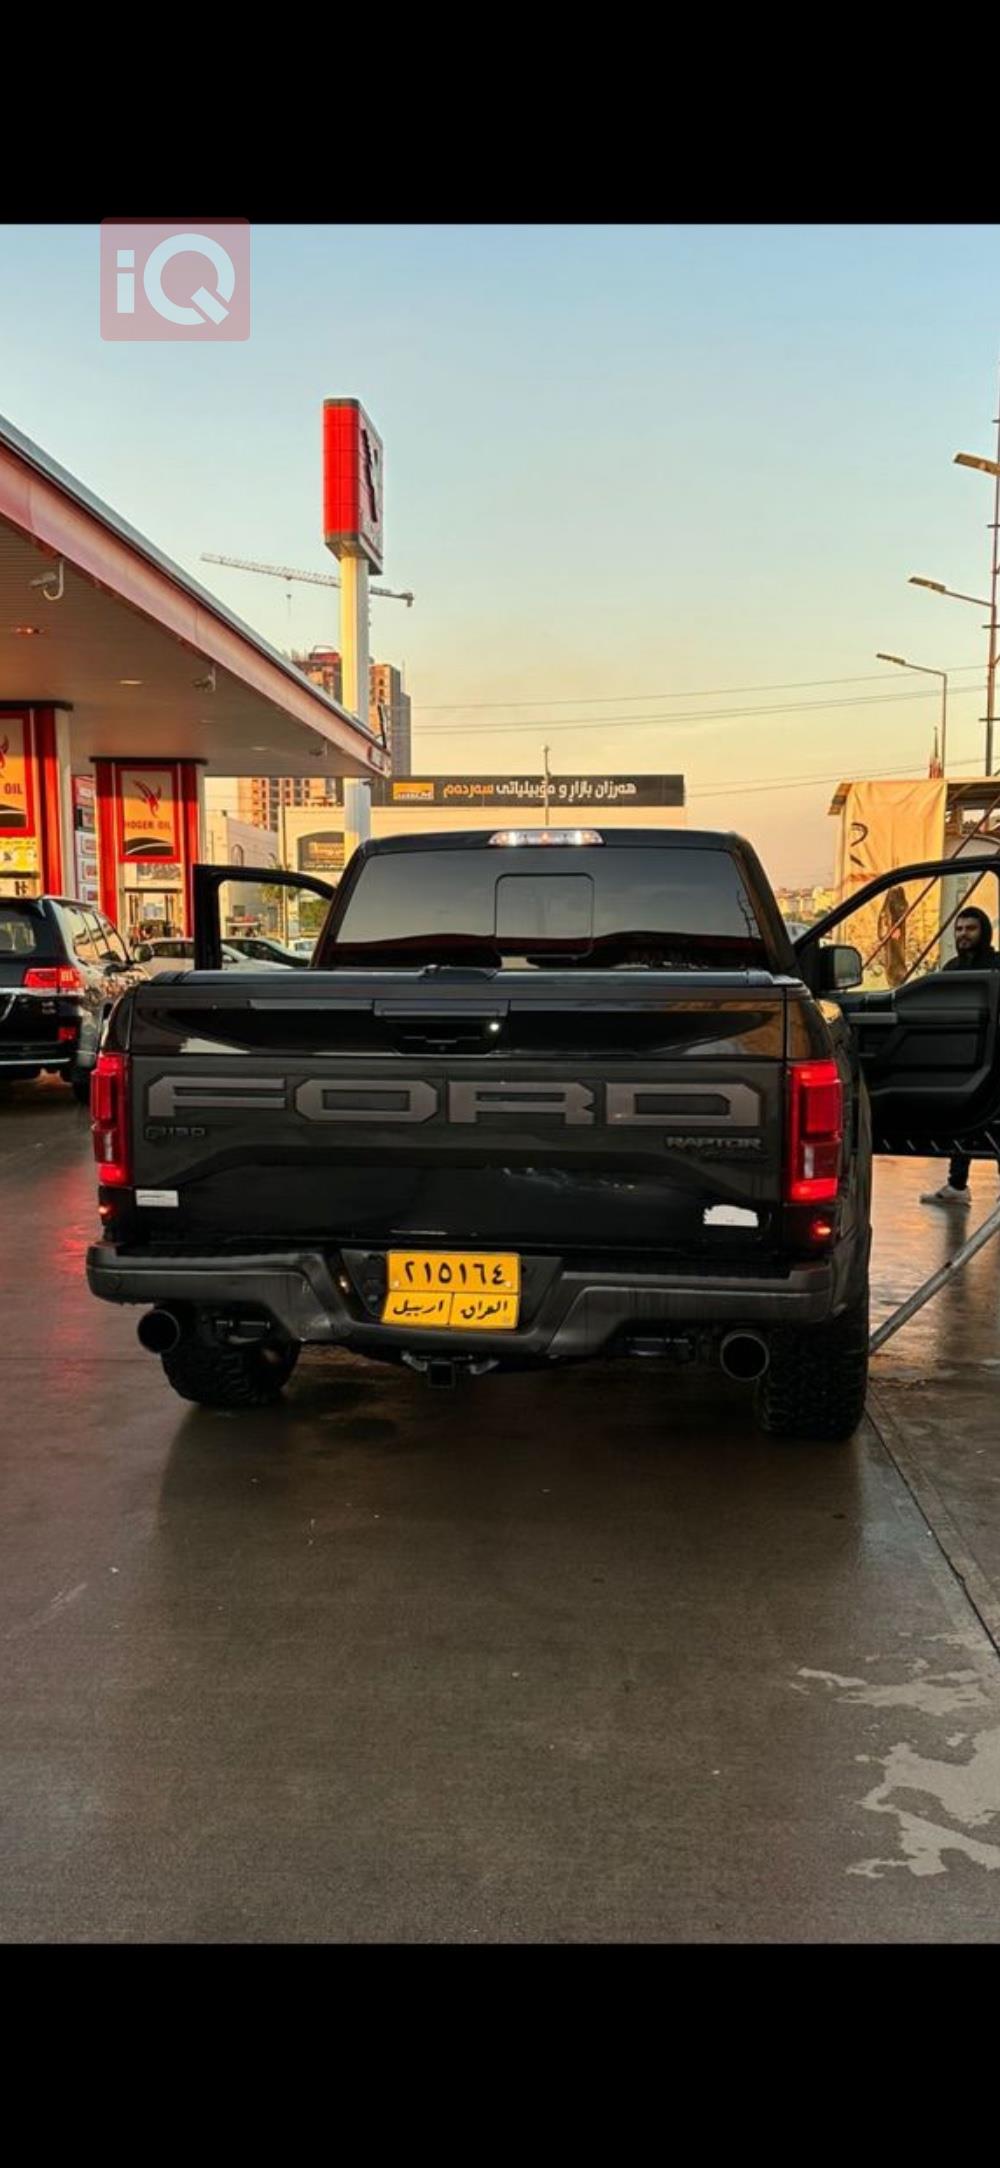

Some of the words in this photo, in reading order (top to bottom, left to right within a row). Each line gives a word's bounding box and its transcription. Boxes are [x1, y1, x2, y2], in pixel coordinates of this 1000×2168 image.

[3, 783, 22, 795] OIL
[148, 1076, 762, 1127] FORD
[665, 1137, 762, 1150] RAPTOR
[404, 1260, 506, 1285] ٢١٥١٦٤
